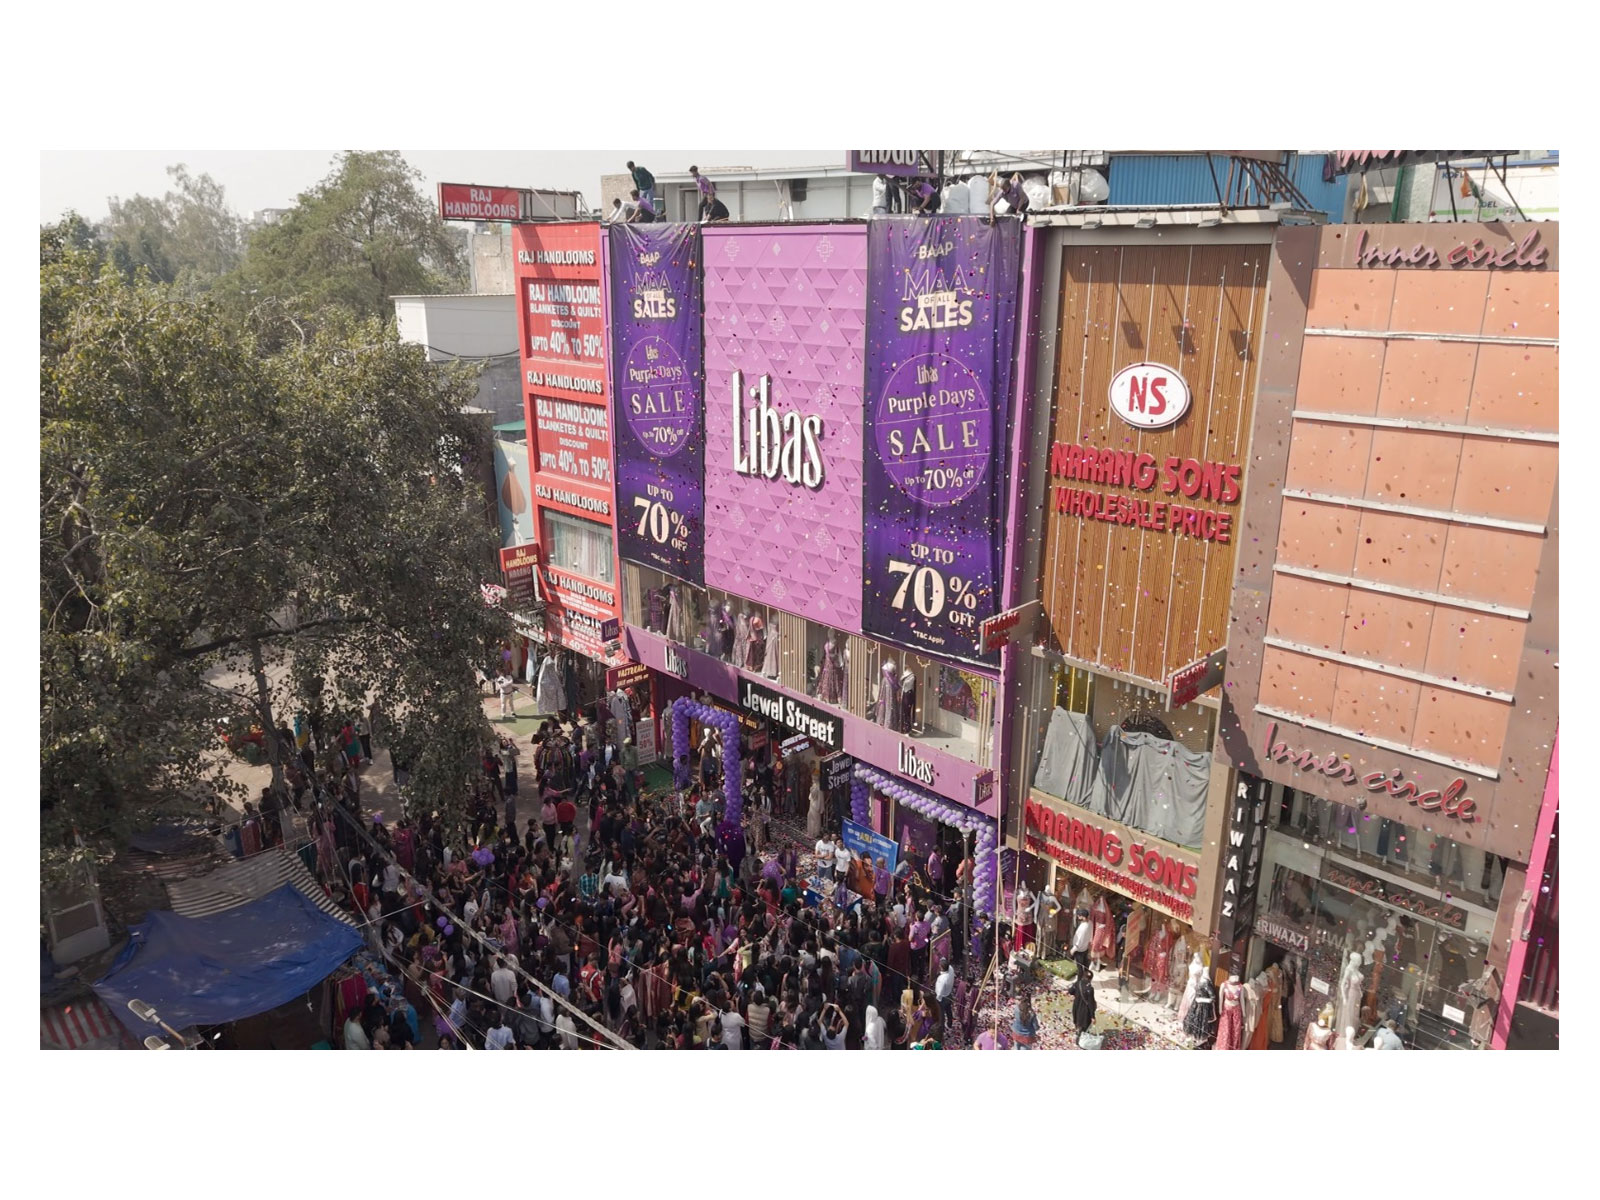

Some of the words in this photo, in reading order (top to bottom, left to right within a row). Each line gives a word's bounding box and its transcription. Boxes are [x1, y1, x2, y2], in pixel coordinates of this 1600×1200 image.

[470, 189, 492, 202] RAJ
[445, 202, 516, 218] HANDLOOMS
[518, 250, 534, 263] RAJ
[538, 250, 594, 264] HANDLOOMS
[640, 252, 660, 264] BAAP
[918, 242, 954, 259] BAAP
[1353, 230, 1440, 266] Inner
[1447, 228, 1547, 266] circle
[528, 284, 546, 300] RAJ
[635, 270, 672, 296] MAA
[902, 264, 968, 301] MAA
[530, 304, 569, 316] BLANKETES
[571, 306, 576, 316] &
[634, 298, 676, 318] SALES
[900, 300, 972, 332] SALES
[552, 319, 580, 328] DISCOUNT
[532, 336, 548, 351] UPTO
[550, 331, 570, 355] 40%
[571, 337, 582, 355] TO
[584, 334, 604, 358] 50%
[527, 371, 544, 385] RAJ
[546, 373, 602, 394] HANDLOOMS
[629, 366, 658, 384] Purple
[660, 365, 682, 381] Days
[917, 364, 938, 384] Libas
[631, 390, 686, 414] SALE
[888, 392, 936, 414] Purple
[939, 388, 976, 408] Days
[1128, 375, 1168, 416] NS
[536, 399, 552, 418] RAJ
[538, 418, 576, 436] BLANKETES
[578, 426, 584, 436] &
[653, 426, 678, 443] 70%
[732, 370, 822, 488] Libas
[890, 420, 979, 456] SALE
[559, 437, 588, 450] DISCOUNT
[540, 452, 556, 469] UPTO
[558, 449, 578, 475] 40%
[579, 458, 590, 477] TO
[592, 456, 610, 482] 50%
[1051, 440, 1157, 490] NARANG
[1162, 456, 1240, 502] SONS
[924, 468, 963, 490] 70%
[536, 484, 552, 499] RAJ
[554, 488, 609, 514] HANDLOOMS
[647, 484, 660, 497] UP
[660, 488, 674, 502] TO
[634, 496, 689, 544] 70%
[1055, 486, 1168, 530] WHOLESALE
[1170, 504, 1232, 542] PRICE
[516, 548, 526, 558] RAJ
[671, 538, 688, 552] OFF
[910, 544, 929, 559] UP
[932, 548, 954, 564] TO
[506, 554, 538, 569] HANDLOOMS
[543, 570, 558, 585] RAJ
[560, 576, 614, 605] HANDLOOMS
[888, 560, 977, 618] 70%
[949, 610, 976, 628] OFF
[928, 634, 945, 645] Apply
[664, 646, 688, 678] Libas
[743, 683, 784, 722] Jewel
[786, 700, 834, 746] Street
[830, 756, 852, 775] Jewel
[898, 741, 934, 784] Libas
[1264, 722, 1357, 782] Inner
[1362, 768, 1476, 820] circle
[828, 772, 850, 790] Stree
[1025, 798, 1122, 865] NARANG
[1128, 843, 1198, 897] SONS
[1222, 782, 1248, 918] RIWAAZ
[1261, 920, 1304, 948] RIWAAZ
